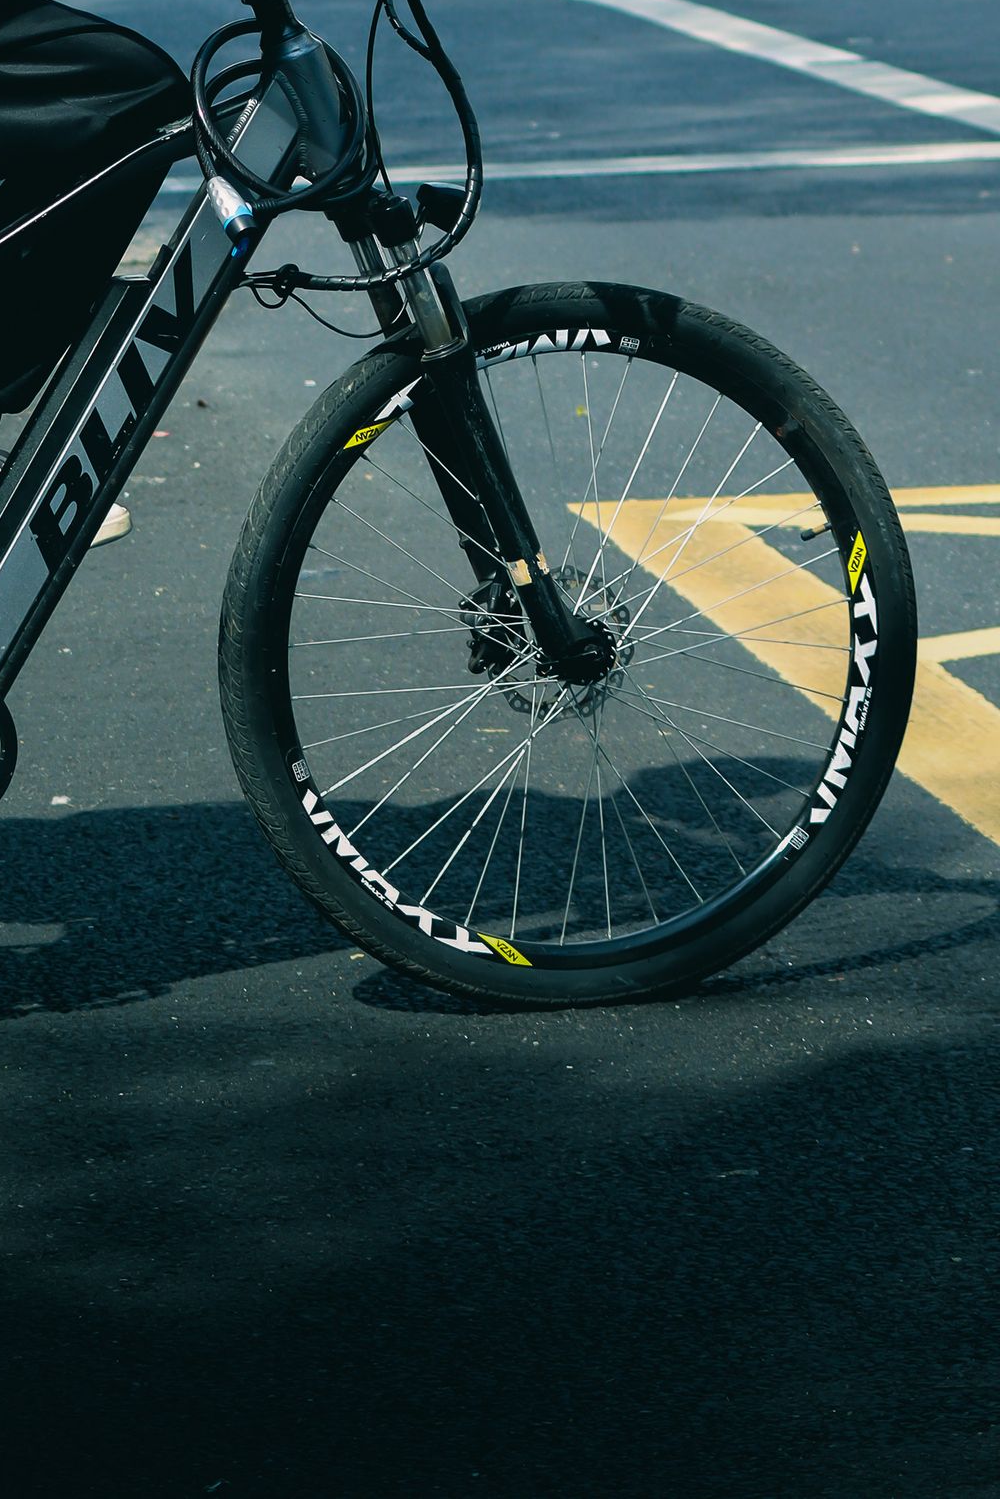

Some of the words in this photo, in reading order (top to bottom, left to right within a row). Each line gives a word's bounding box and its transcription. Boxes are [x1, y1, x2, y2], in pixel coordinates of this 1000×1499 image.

[374, 328, 611, 422] VMAX
[850, 546, 864, 573] VZAN
[810, 573, 878, 823] VMAXX
[302, 788, 494, 954] VMAXX
[496, 940, 519, 962] VZAN
